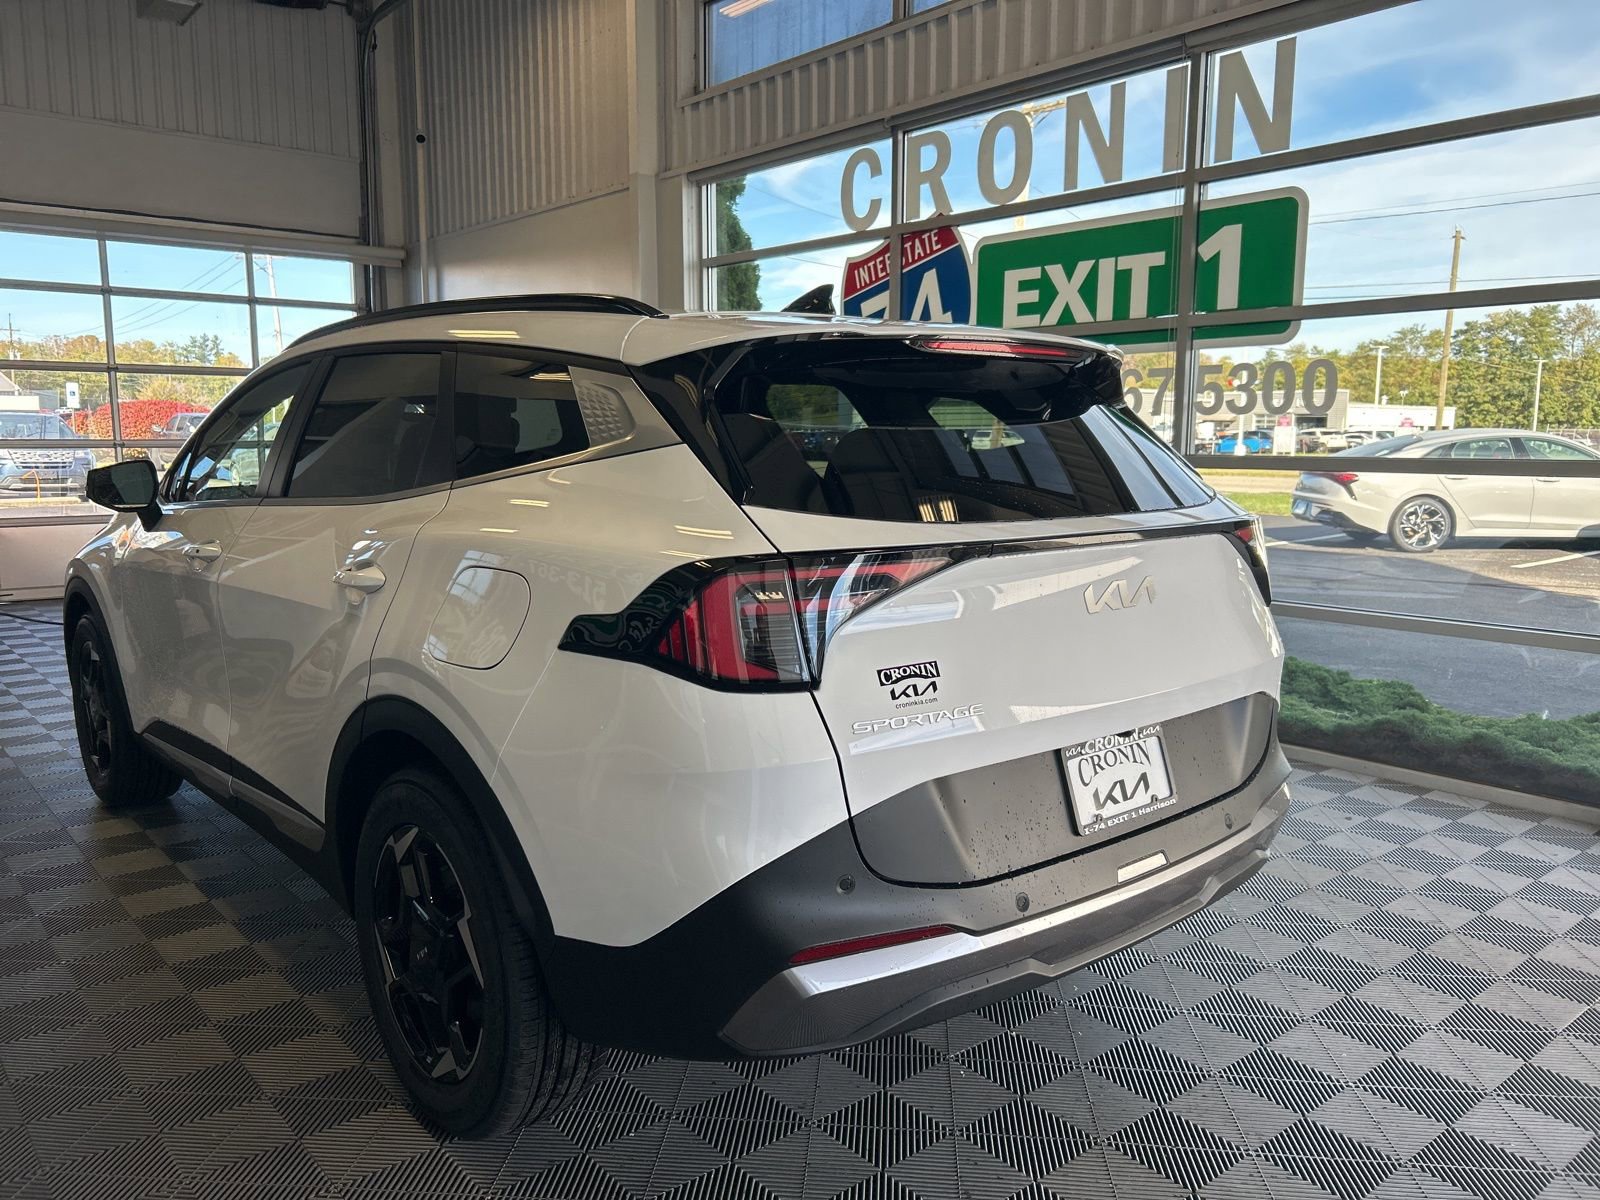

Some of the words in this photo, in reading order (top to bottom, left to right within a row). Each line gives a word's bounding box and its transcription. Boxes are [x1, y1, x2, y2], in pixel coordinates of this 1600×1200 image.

[840, 37, 1297, 232] CRONIN
[854, 229, 942, 289] INTERTATE
[1003, 251, 1166, 330] EXIT
[1198, 223, 1243, 311] 1
[1083, 575, 1155, 614] KIA
[880, 662, 938, 685] CRONIN
[890, 681, 938, 700] KIA
[852, 703, 985, 734] SPORTAGE
[895, 697, 938, 709] croninkia.com
[1078, 741, 1152, 787] CRONIN
[1092, 772, 1150, 811] KIA
[1084, 823, 1105, 835] I-74
[1107, 814, 1129, 827] EXIT
[1131, 811, 1137, 819] 1
[1138, 798, 1177, 816] Harrison
